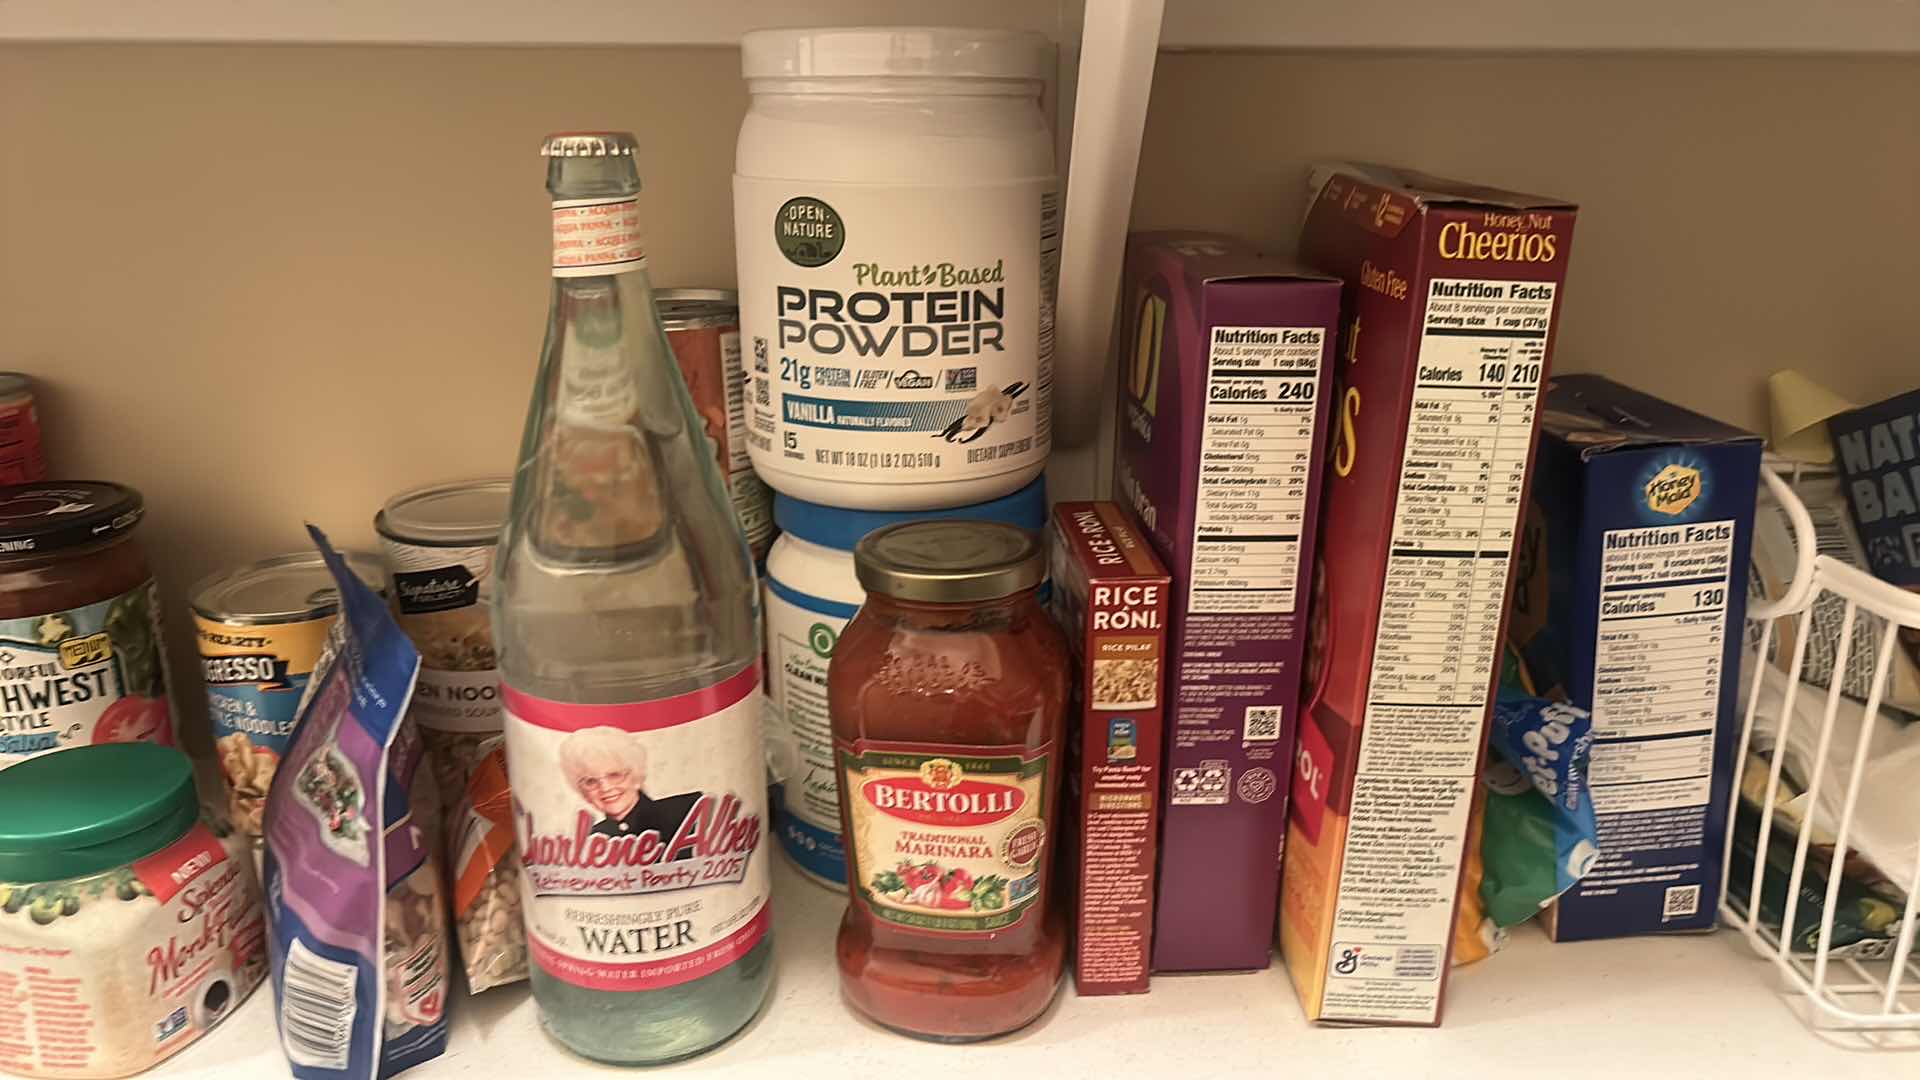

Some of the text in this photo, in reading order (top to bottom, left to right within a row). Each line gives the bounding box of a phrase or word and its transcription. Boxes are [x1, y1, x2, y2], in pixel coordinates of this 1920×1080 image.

[788, 205, 825, 221] OPEN
[1484, 213, 1553, 232] Honey Nut
[783, 223, 834, 239] NATURE
[1438, 222, 1557, 263] Cheerios
[852, 258, 1004, 288] Plant Based
[1360, 259, 1408, 301] Gluten Free
[1432, 282, 1552, 300] Nutrition Facts
[777, 286, 1004, 324] PROTEIN
[1428, 302, 1453, 312] About
[1461, 304, 1495, 316] servings
[1495, 306, 1510, 315] per
[1510, 307, 1548, 315] container
[1426, 315, 1463, 326] Serving
[1465, 316, 1486, 325] size
[1503, 319, 1521, 328] cup
[1522, 318, 1548, 329] (37g)
[779, 320, 1005, 358] POWDER
[1215, 329, 1321, 344] Nutrition Facts
[1212, 357, 1243, 368] Serving
[1244, 358, 1261, 367] size
[1279, 359, 1295, 368] cup
[780, 357, 811, 389] 21g
[1419, 363, 1540, 383] Calories 140 210
[1210, 382, 1315, 400] Calories 240
[786, 400, 835, 424] VANILLA
[784, 431, 798, 450] 15
[1839, 412, 1920, 475] NAT
[815, 450, 829, 465] NET
[831, 451, 844, 466] WT
[967, 446, 997, 464] DIETARY
[1649, 473, 1697, 496] Honey
[1656, 489, 1692, 508] Maid
[1606, 525, 1731, 549] Nutrition Facts
[1606, 563, 1636, 573] Serving
[1637, 562, 1654, 570] size
[1670, 557, 1706, 568] crackers
[1094, 586, 1158, 606] RICE
[1602, 588, 1725, 615] Calories 130
[0, 668, 108, 713] HWEST
[874, 783, 1014, 815] BERTOLLI
[900, 830, 987, 846] TRADITIONAL
[895, 839, 993, 859] MARINARA
[170, 850, 212, 885] NEW
[641, 866, 701, 888] Party
[703, 857, 744, 881] 2005
[577, 919, 697, 954] WATER
